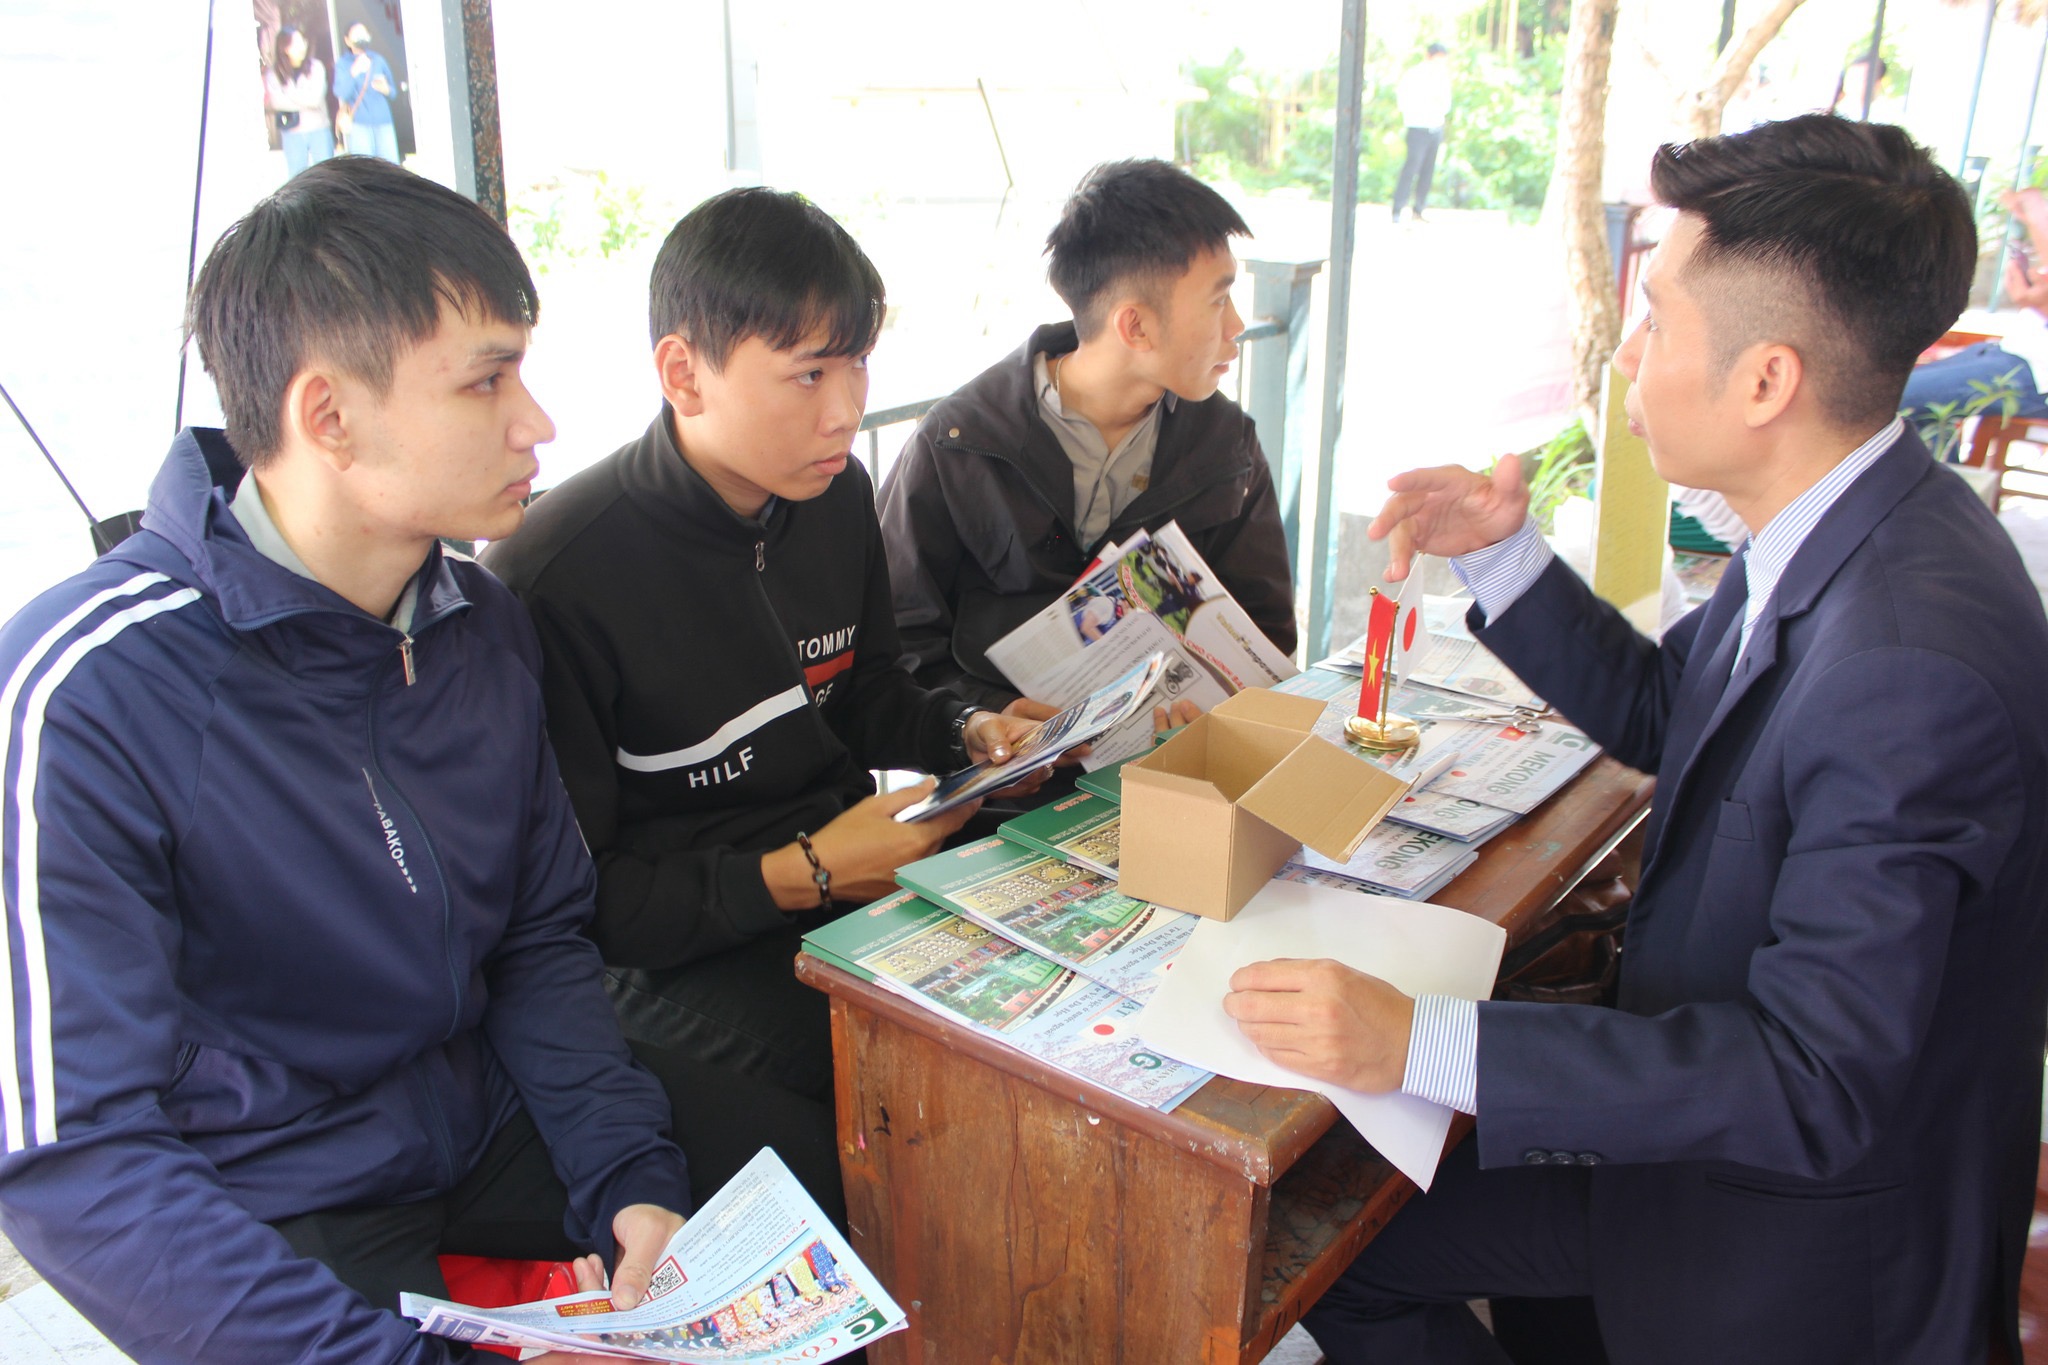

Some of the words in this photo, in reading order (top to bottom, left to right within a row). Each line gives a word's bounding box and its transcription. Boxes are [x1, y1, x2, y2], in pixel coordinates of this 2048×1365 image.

[797, 625, 857, 661] TOMMY
[688, 746, 754, 788] HILF
[1487, 751, 1556, 794] MEKONG
[1434, 799, 1481, 819] ONG
[1374, 831, 1445, 870] EKONG
[1128, 945, 1145, 954] Học
[1143, 939, 1156, 947] Du
[1053, 1007, 1069, 1018] Học
[1067, 1000, 1081, 1009] Du
[1129, 1053, 1162, 1070] G
[841, 1303, 875, 1325] MEKONG
